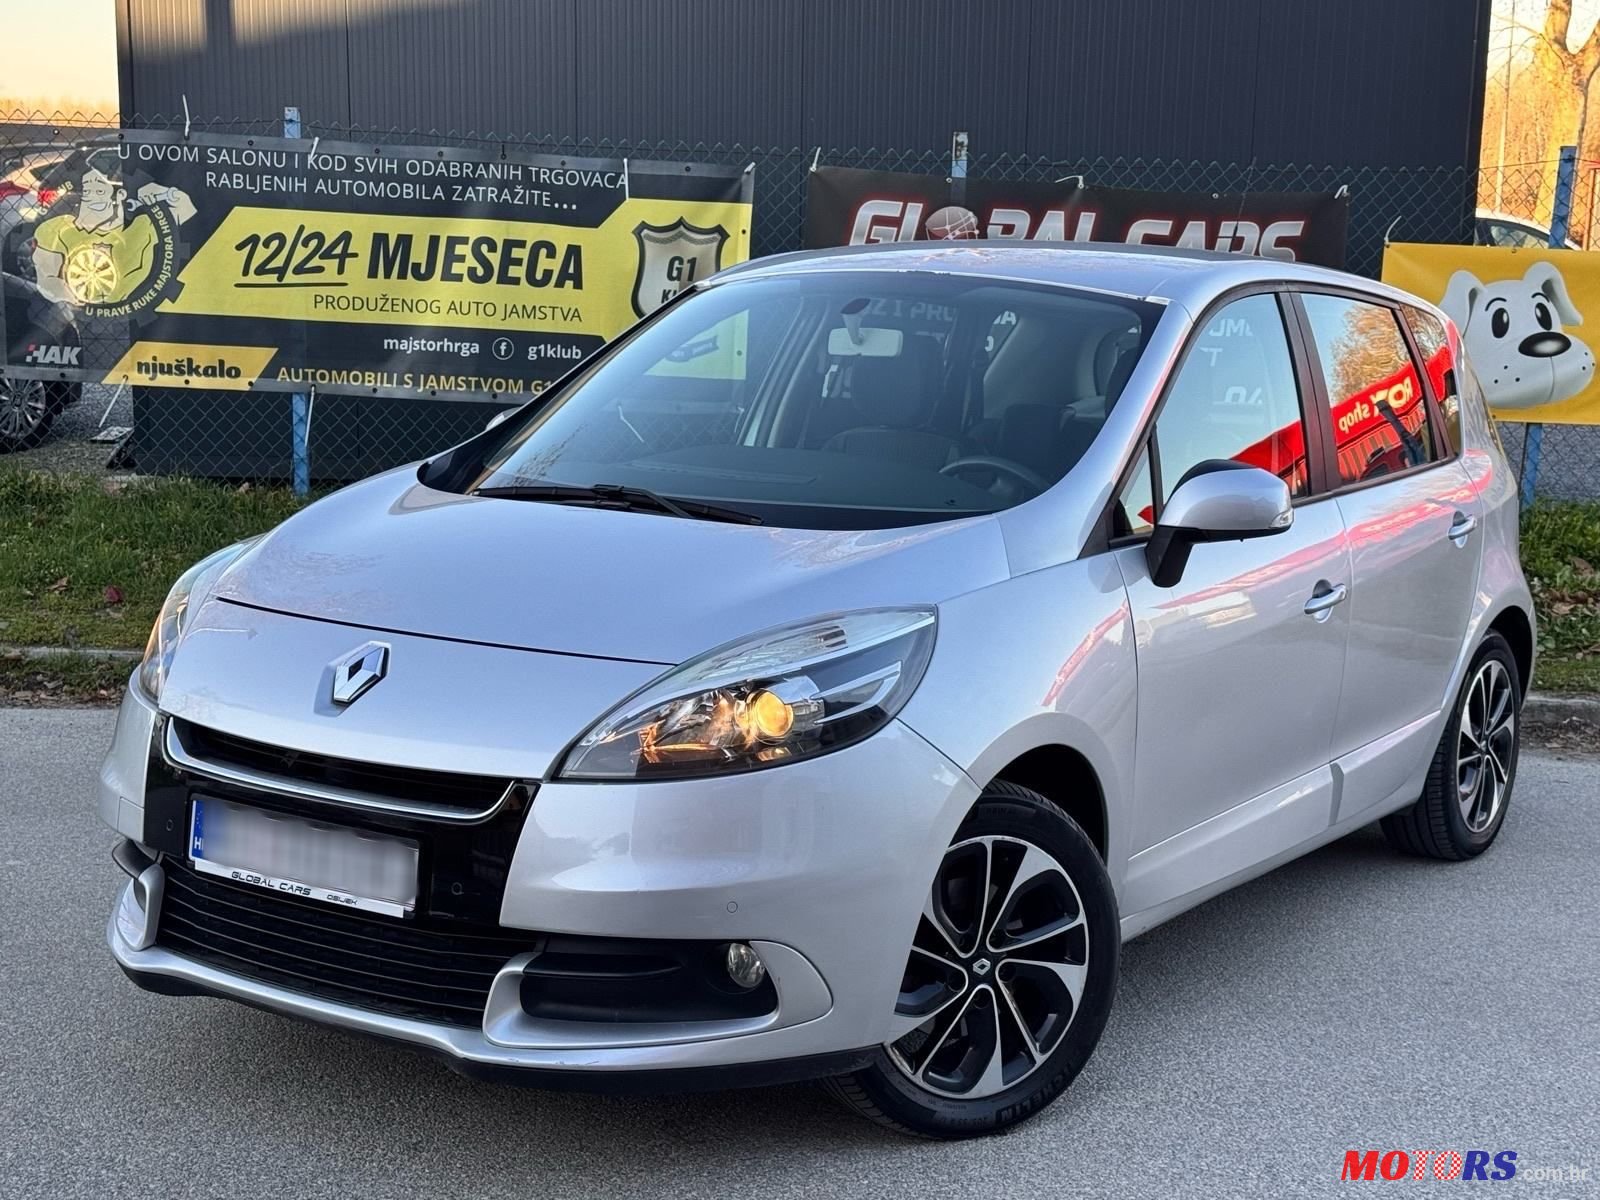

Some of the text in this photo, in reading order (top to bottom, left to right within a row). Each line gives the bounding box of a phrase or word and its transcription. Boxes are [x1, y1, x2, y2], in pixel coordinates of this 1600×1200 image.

[117, 144, 627, 189] U OVOM SALONU I KOD SVIH ODABRANIH TRGOVACA
[205, 172, 577, 210] RABLJENIH AUTOMOBILA ZATRAŽITE...
[85, 205, 174, 317] U PRAVE RUKE MAJSTORA HRGE
[235, 224, 584, 290] 12/24 MJESECA
[666, 255, 698, 282] G1
[313, 293, 583, 323] PRODUŽENOG AUTO JAMSTVA
[383, 336, 480, 358] majstorhrga
[527, 343, 582, 360] g1klub
[136, 355, 242, 382] njuškalo
[277, 366, 397, 388] AUTOMOBILI
[403, 373, 413, 387] S
[416, 373, 524, 394] JAMSTVOM
[231, 871, 275, 889] GLOBAL
[278, 881, 311, 896] CARS
